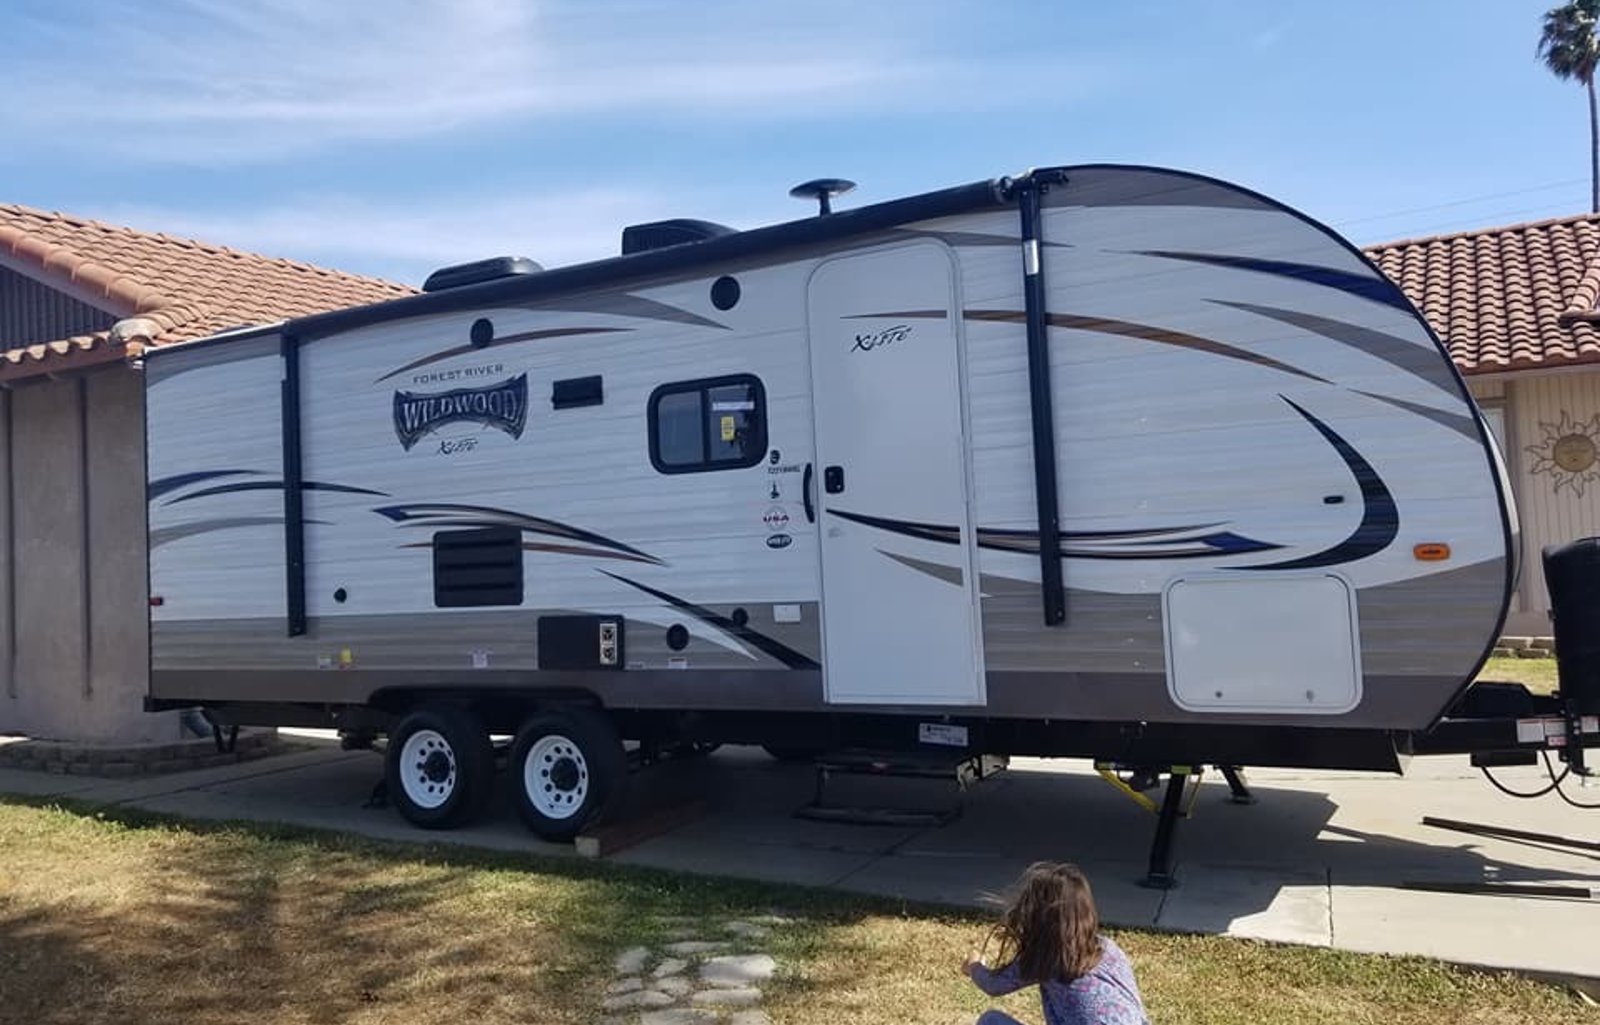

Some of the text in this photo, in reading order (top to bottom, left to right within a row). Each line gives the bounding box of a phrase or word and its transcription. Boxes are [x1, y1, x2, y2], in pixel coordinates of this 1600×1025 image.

[413, 364, 503, 383] FOREST RIVER
[403, 389, 518, 432] WILDWOOD
[763, 514, 789, 522] USA
